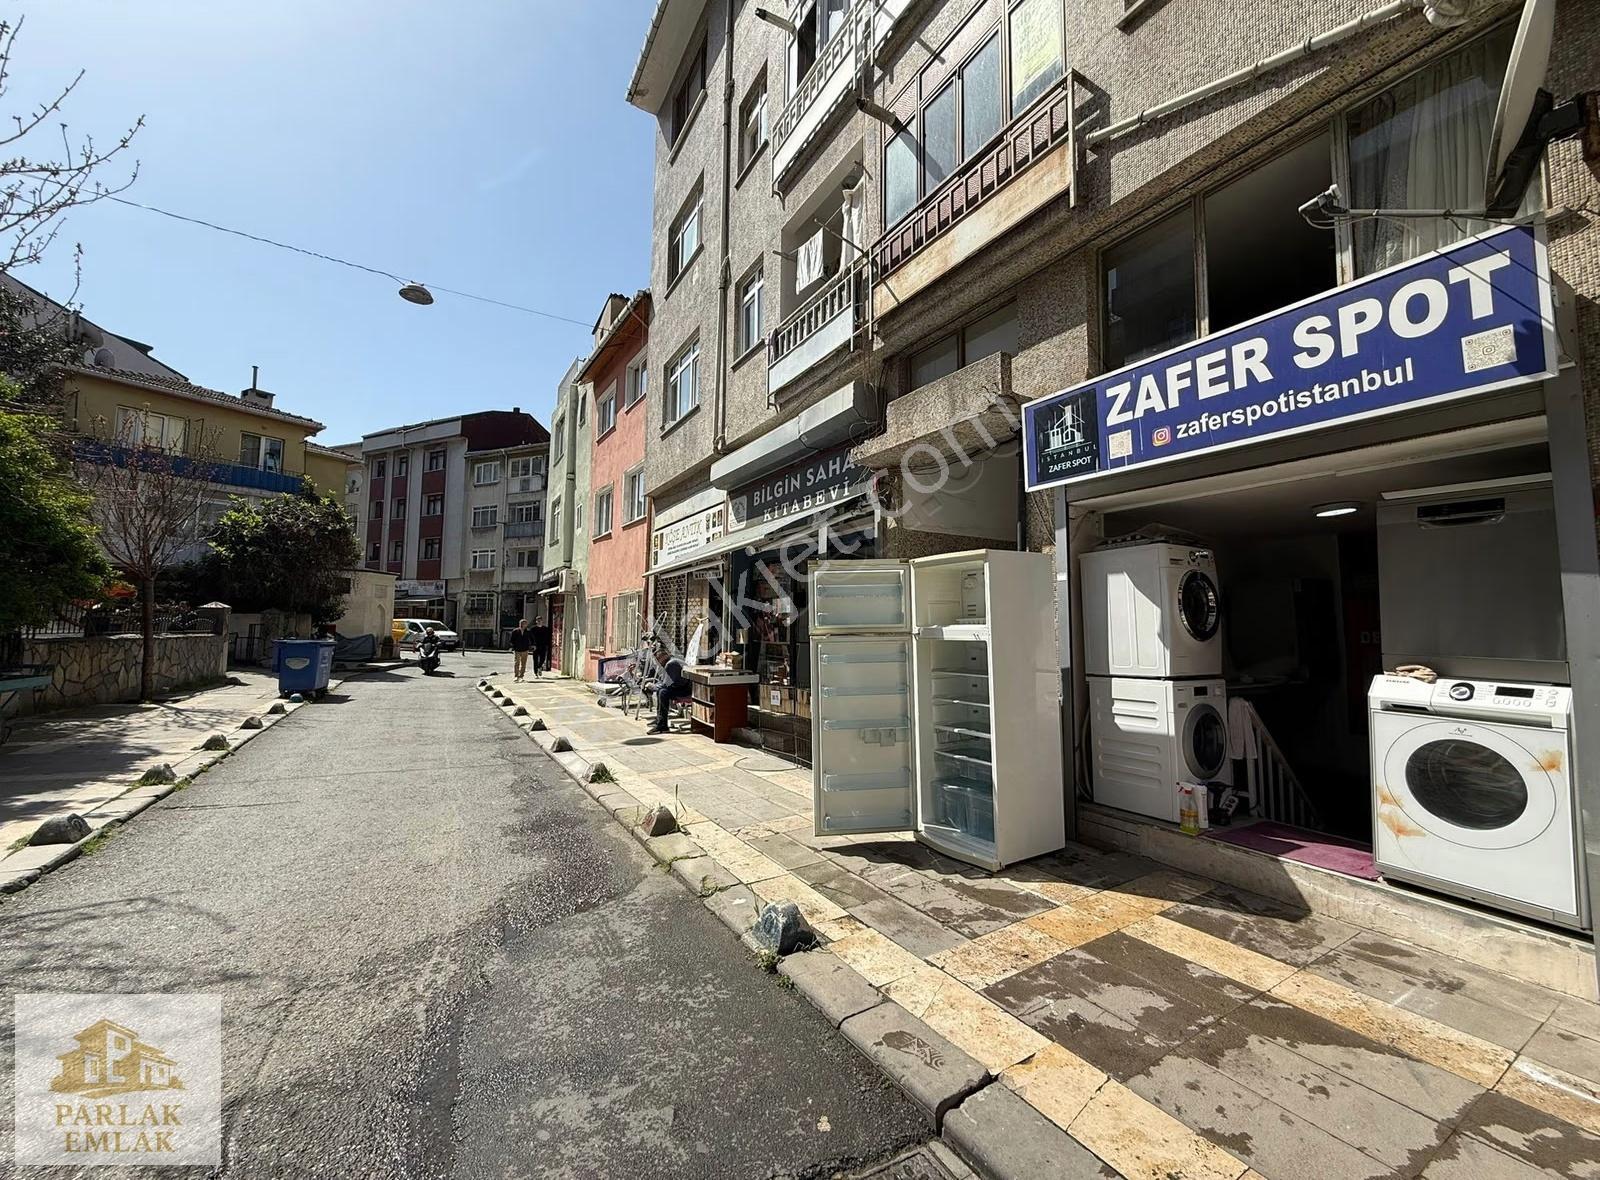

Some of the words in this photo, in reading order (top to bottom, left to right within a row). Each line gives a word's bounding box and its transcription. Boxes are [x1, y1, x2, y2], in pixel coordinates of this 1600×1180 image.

[1105, 337, 1274, 427] ZAFER
[1292, 250, 1511, 369] SPOT
[1176, 357, 1414, 440] zaferspotistanbul
[753, 473, 801, 507] BİLGİN
[806, 452, 862, 487] SAHA
[1048, 460, 1072, 473] ZAFER
[1072, 455, 1092, 467] SPOT
[763, 476, 850, 522] KİTABEVİ
